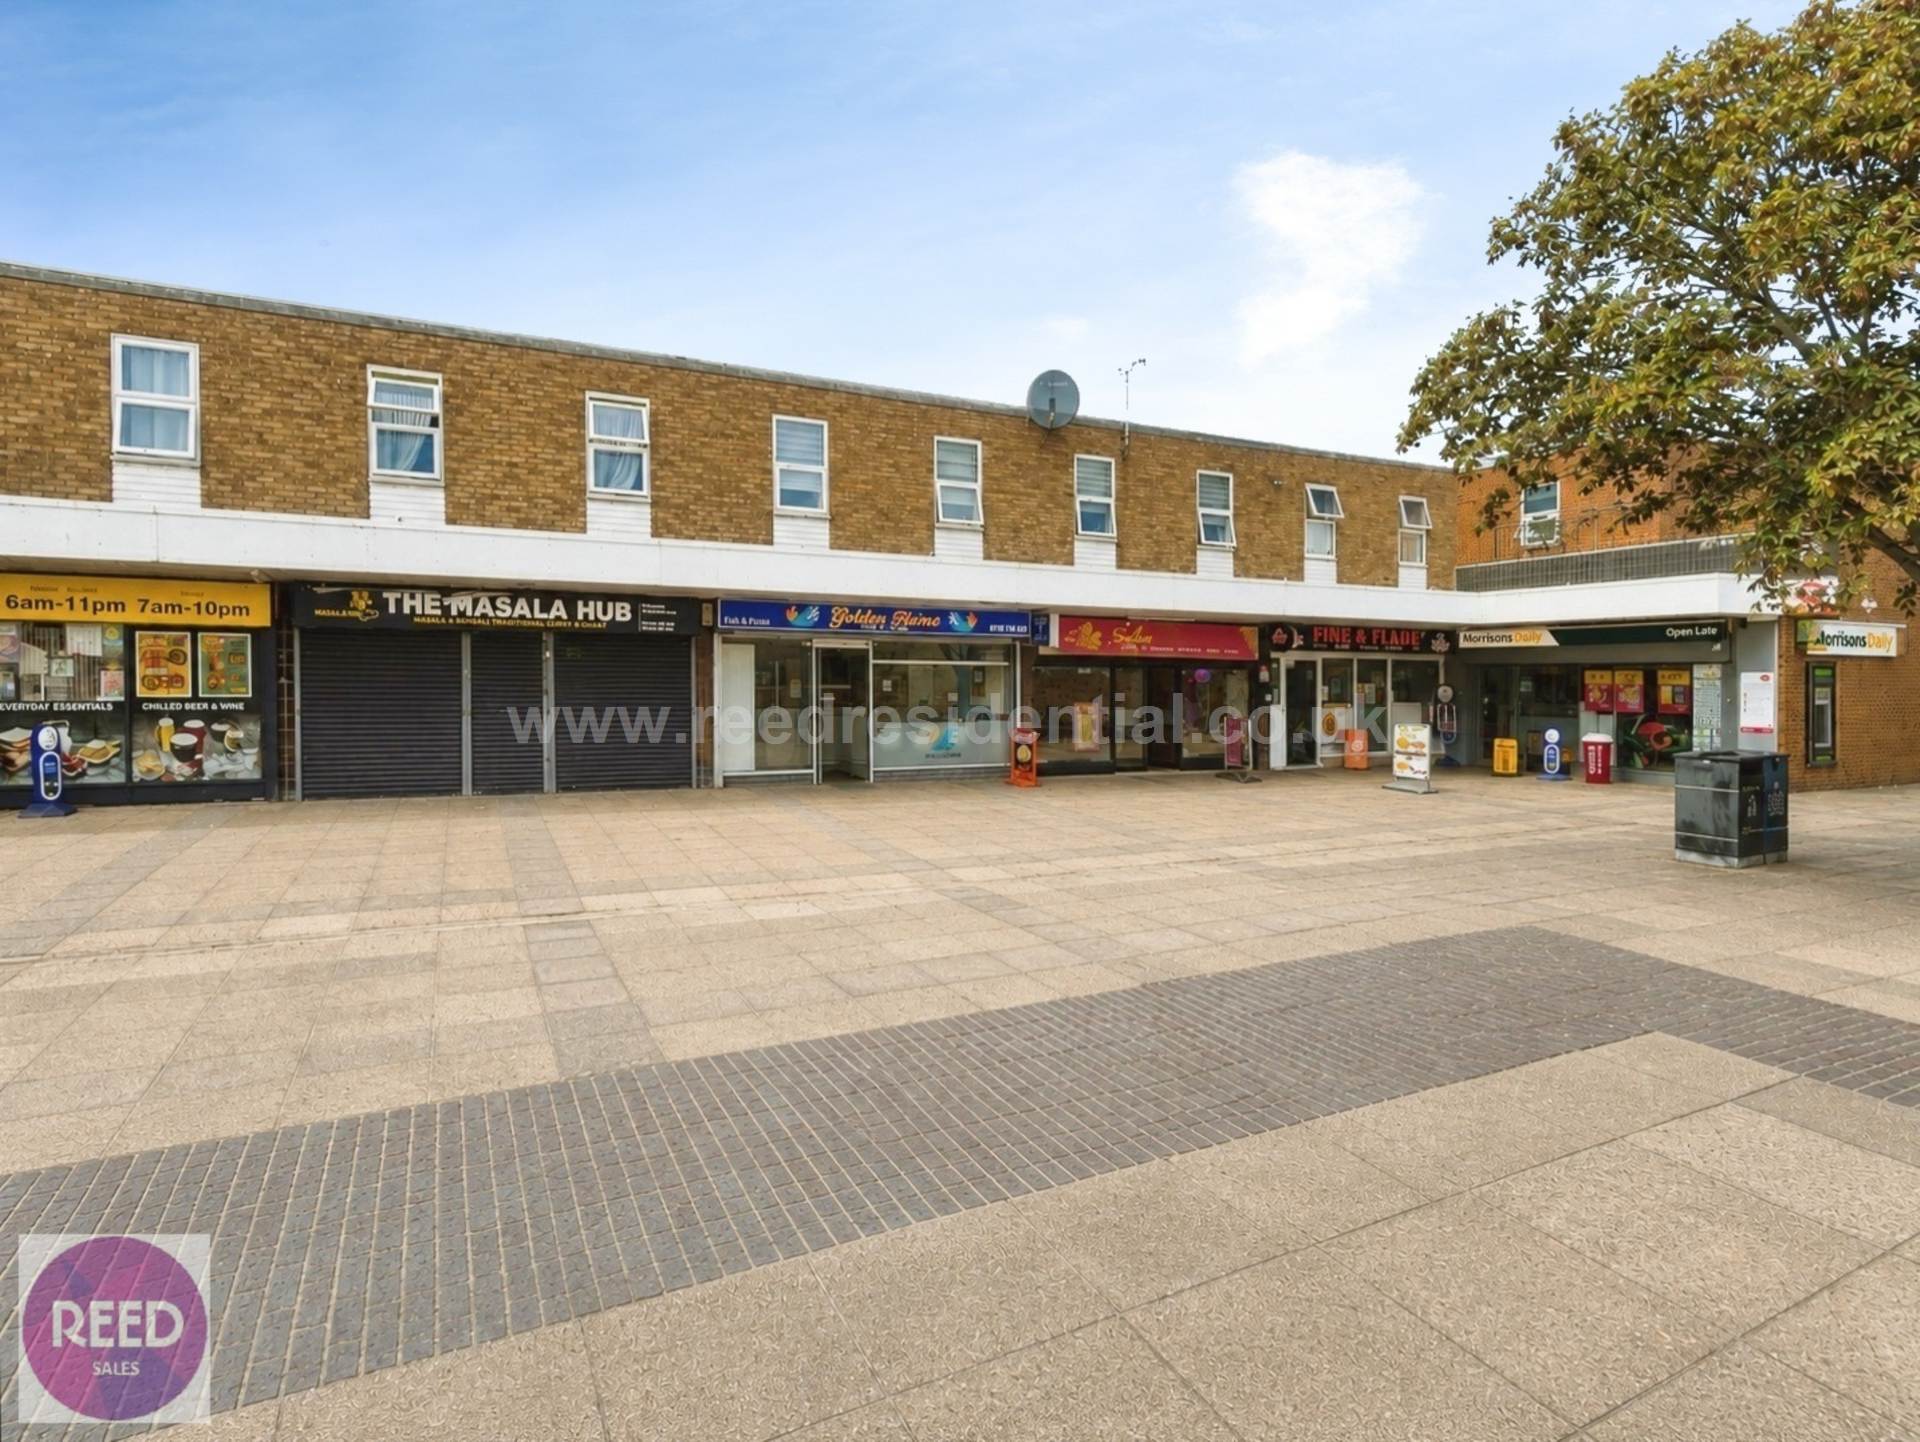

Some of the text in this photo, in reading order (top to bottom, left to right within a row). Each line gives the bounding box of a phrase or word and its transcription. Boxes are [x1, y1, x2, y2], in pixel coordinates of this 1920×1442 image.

[5, 594, 250, 619] 6am-11pm 7am-10pm
[382, 591, 442, 615] THE
[449, 596, 567, 620] MASALA
[577, 600, 632, 622] HUB
[829, 606, 886, 628] Golden
[1313, 626, 1351, 643] FINE
[1356, 628, 1367, 644] &
[1462, 631, 1542, 644] Morrisons Daily
[1666, 626, 1718, 639] Open Late
[1867, 633, 1894, 653] Daily
[0, 702, 114, 711] EVERYDAY ESSENTIALS
[142, 702, 182, 710] CHILLED
[184, 702, 209, 710] BEER
